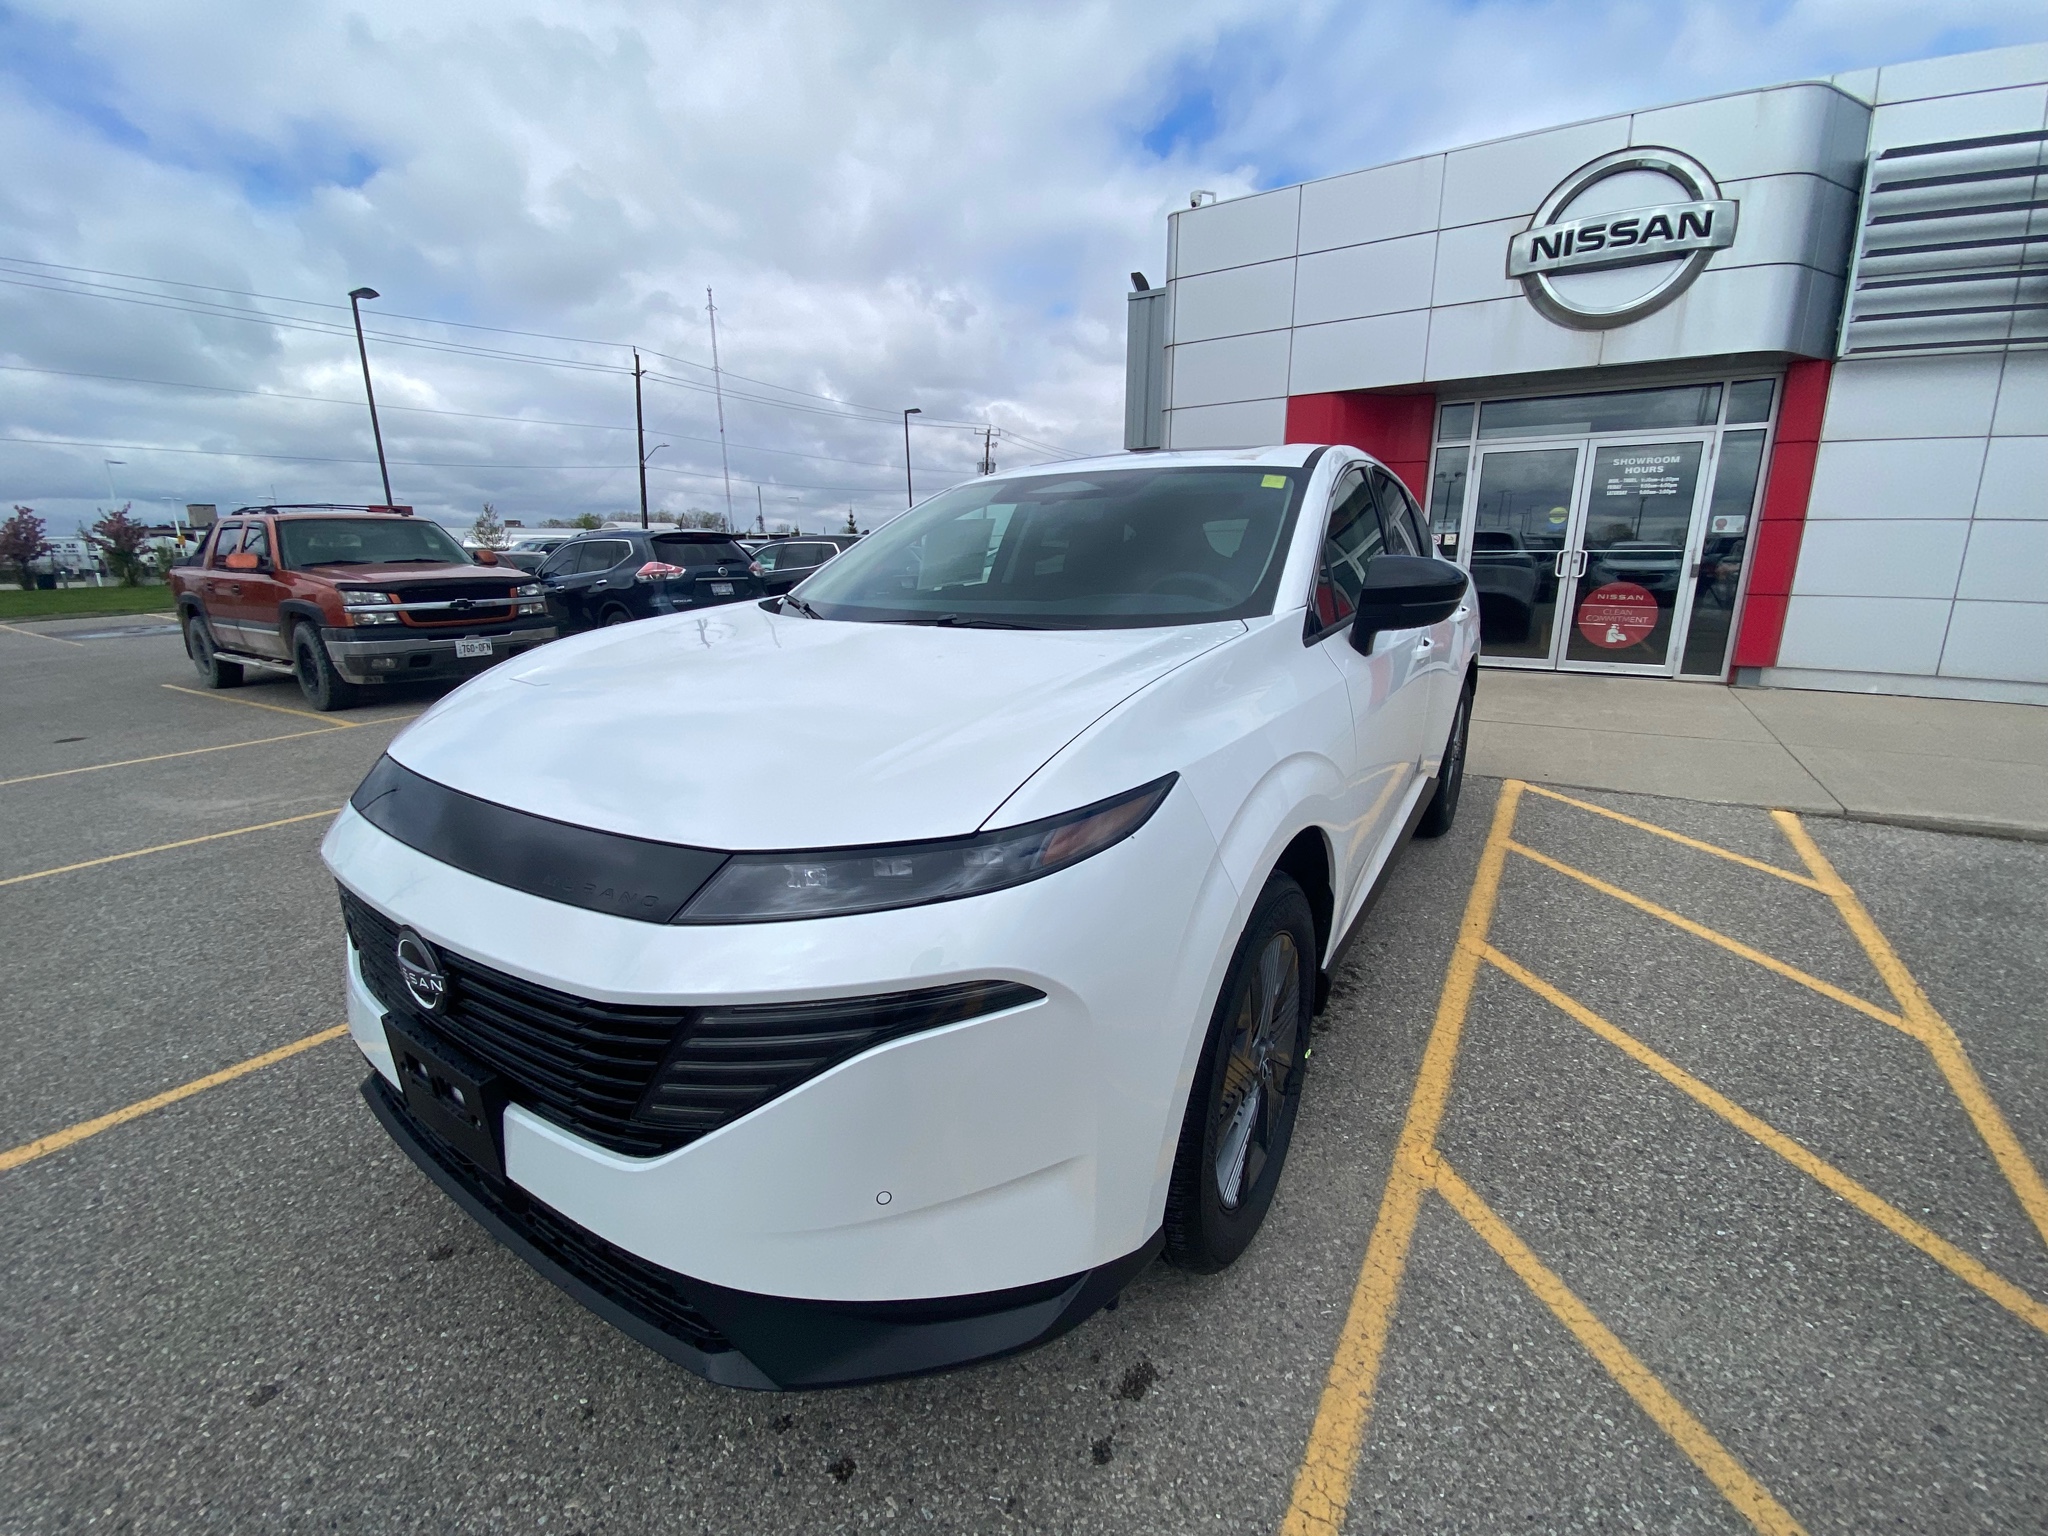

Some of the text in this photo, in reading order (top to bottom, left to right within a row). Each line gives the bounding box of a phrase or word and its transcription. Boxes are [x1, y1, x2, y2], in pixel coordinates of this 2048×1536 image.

[1530, 210, 1714, 262] NISSAN
[1613, 456, 1680, 466] SHOWROOM
[1625, 466, 1664, 474] HOURS
[1603, 608, 1633, 616] CLEAN
[1586, 615, 1649, 624] COMMITMENT
[541, 875, 660, 907] RANO
[401, 967, 443, 992] SSAN
